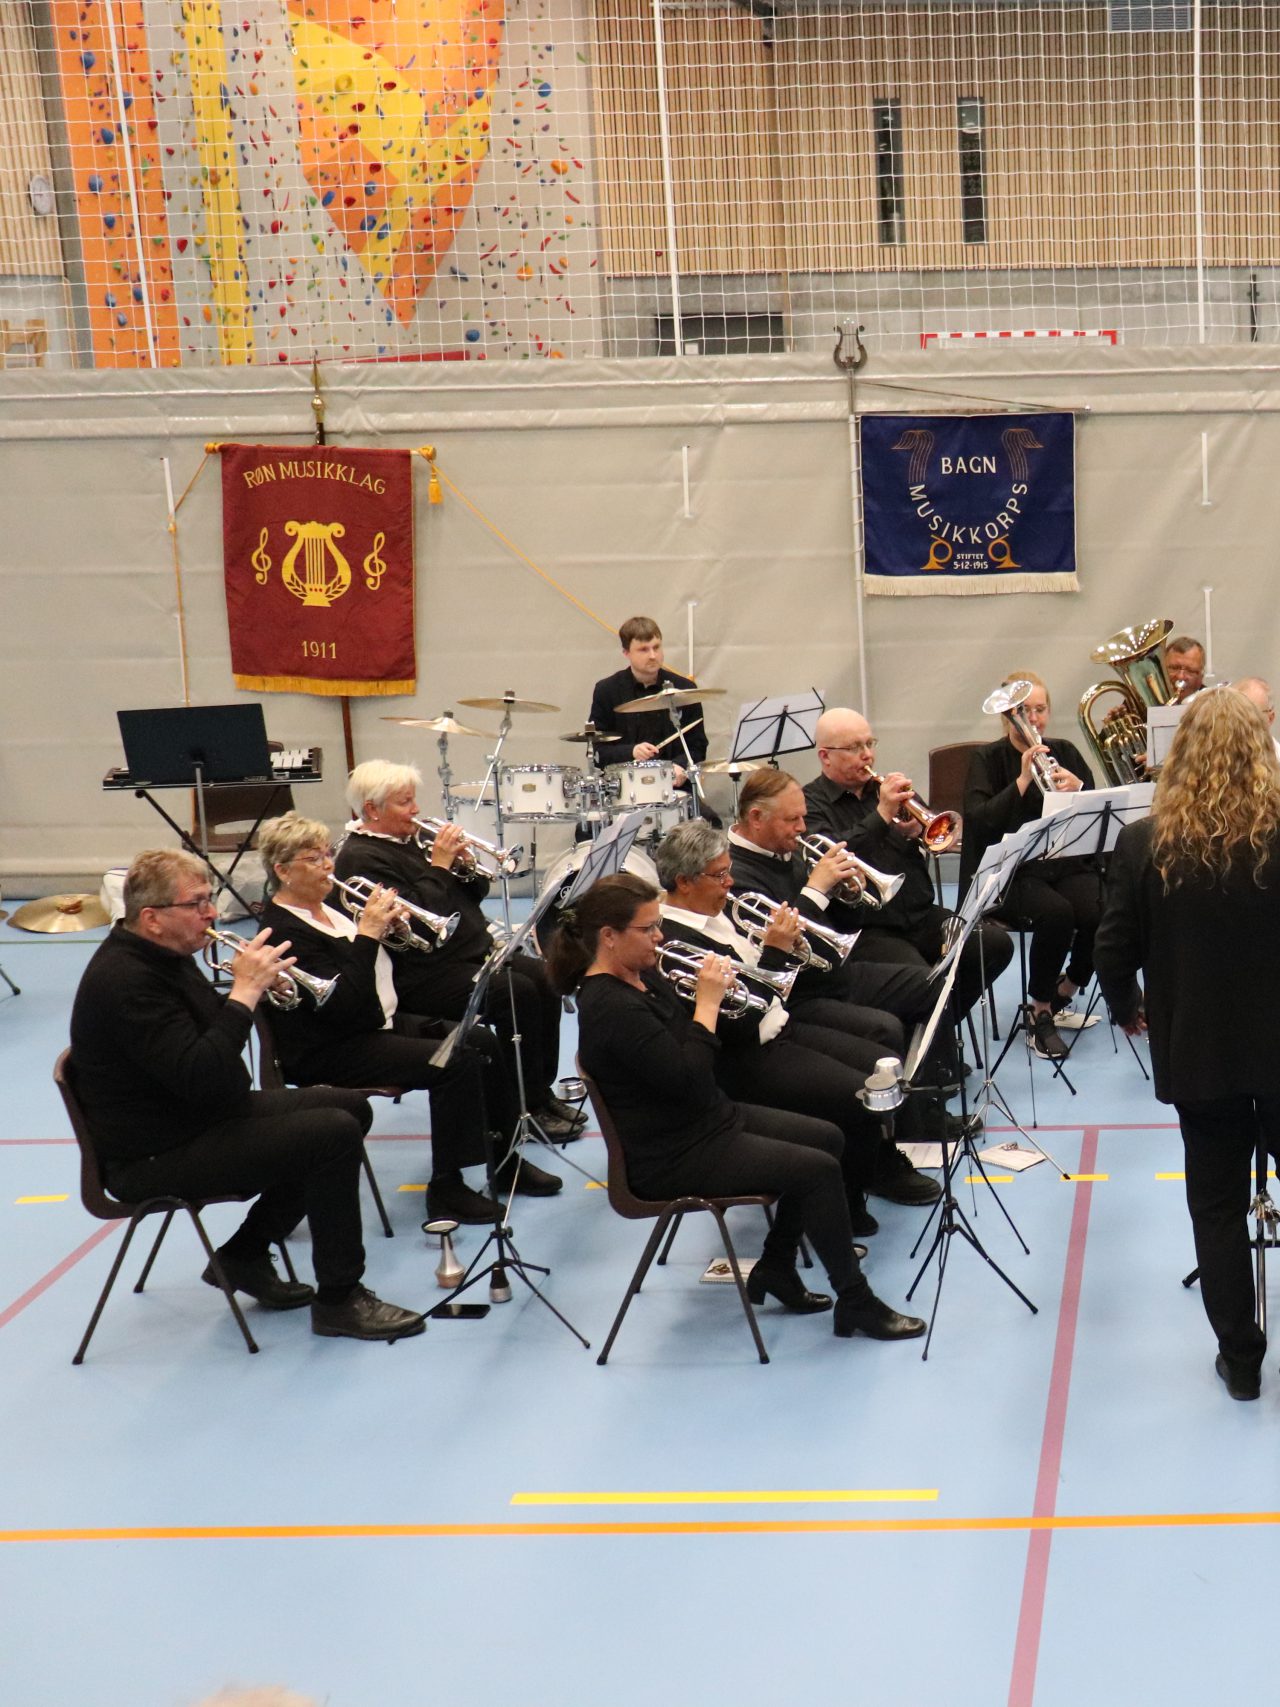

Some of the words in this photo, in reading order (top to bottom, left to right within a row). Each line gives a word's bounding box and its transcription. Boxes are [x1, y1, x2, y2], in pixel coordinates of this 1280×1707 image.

[243, 464, 276, 489] RØN
[279, 460, 386, 495] MUSIKKLAG
[941, 456, 996, 475] BAGN
[908, 483, 1028, 544] MUSIKKORPS
[301, 640, 337, 660] 1911
